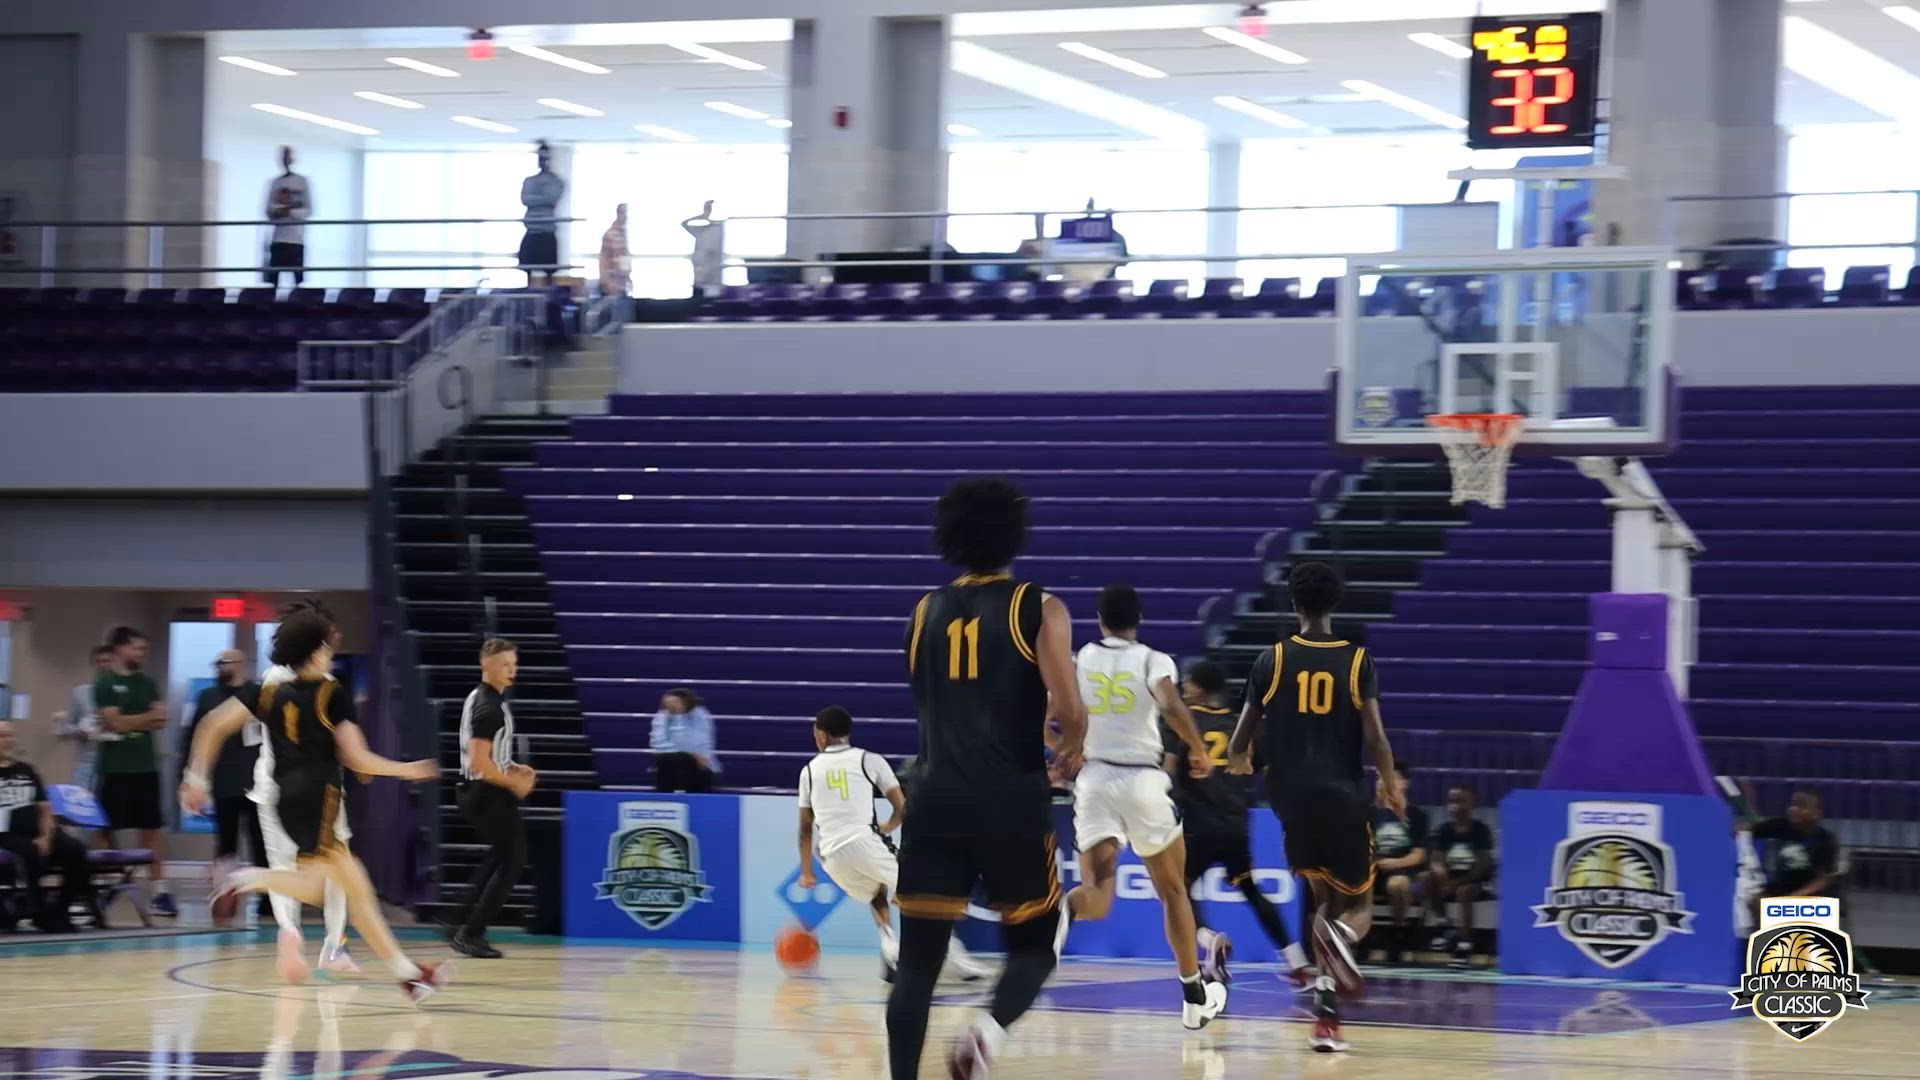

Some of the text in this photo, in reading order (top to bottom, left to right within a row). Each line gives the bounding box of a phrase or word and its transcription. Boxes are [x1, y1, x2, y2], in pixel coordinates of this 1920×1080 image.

[1490, 67, 1575, 134] 32
[947, 617, 981, 680] 11
[1086, 672, 1136, 714] 35
[1297, 670, 1334, 714] 10
[826, 767, 849, 801] 4
